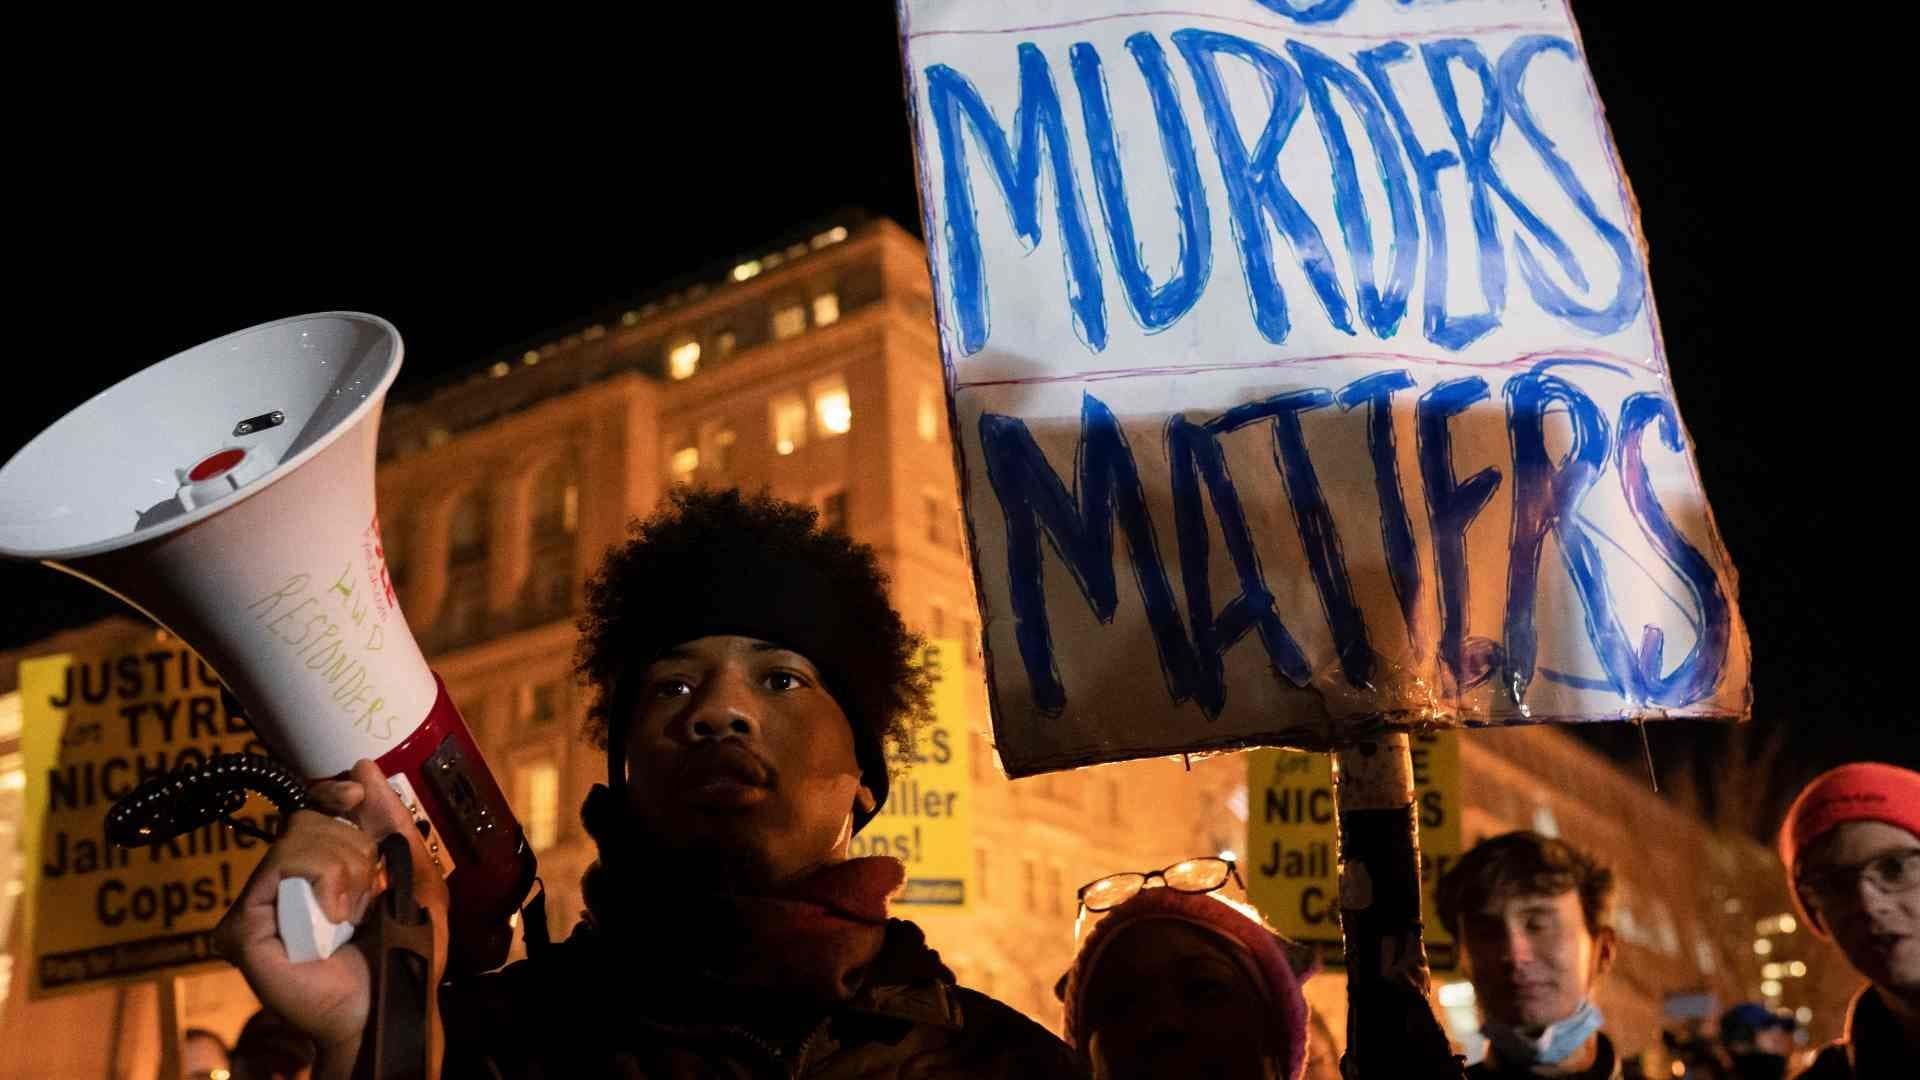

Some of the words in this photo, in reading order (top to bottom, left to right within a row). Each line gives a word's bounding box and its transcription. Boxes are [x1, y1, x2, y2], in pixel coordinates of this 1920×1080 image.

[926, 28, 1646, 354] MURDERS
[980, 366, 1734, 719] MATTERS
[48, 650, 223, 708] JUSTIC
[247, 573, 400, 740] RESPONDERS
[120, 688, 253, 748] TYRE
[879, 780, 959, 817] iller
[850, 827, 922, 863] ops!
[1260, 841, 1328, 879] Jail
[96, 862, 232, 927] Cops!
